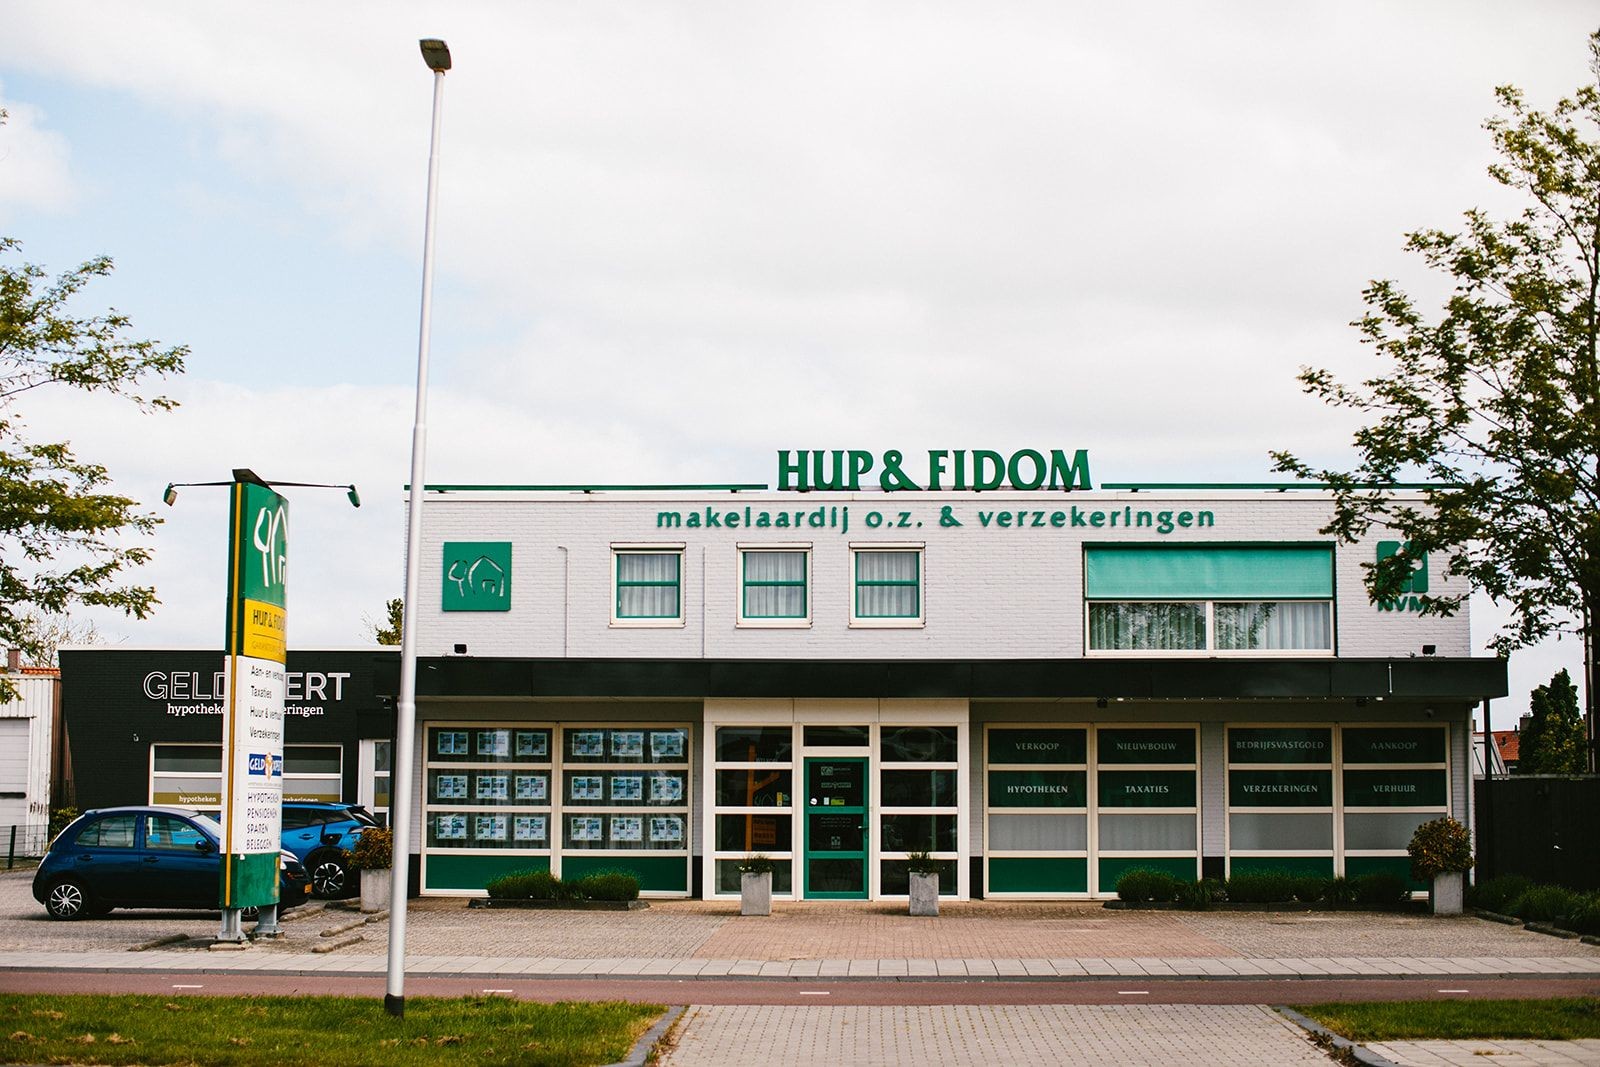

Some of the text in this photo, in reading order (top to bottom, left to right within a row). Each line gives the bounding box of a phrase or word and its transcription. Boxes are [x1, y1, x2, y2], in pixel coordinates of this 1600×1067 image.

[777, 449, 1093, 491] HUP & FIDOM
[657, 505, 1215, 534] makelaardij o.z. & verzekeringen
[1377, 595, 1426, 612] NVM
[253, 609, 268, 627] HUP
[250, 685, 272, 699] Taxaties
[250, 706, 264, 718] Huur
[1236, 741, 1324, 751] BEDRIJFSVASTGOED
[1370, 742, 1417, 750] AANKOOP
[249, 757, 265, 771] GELD
[1007, 785, 1068, 793] HYPOTHEKEN
[1125, 785, 1169, 793] TAXATIES
[1243, 784, 1318, 793] VERZEKERINGEN
[1373, 784, 1416, 793] VERHUUR
[179, 796, 217, 804] hypotheken
[246, 823, 269, 834] SPAREN
[246, 838, 273, 850] BELEGGEN
